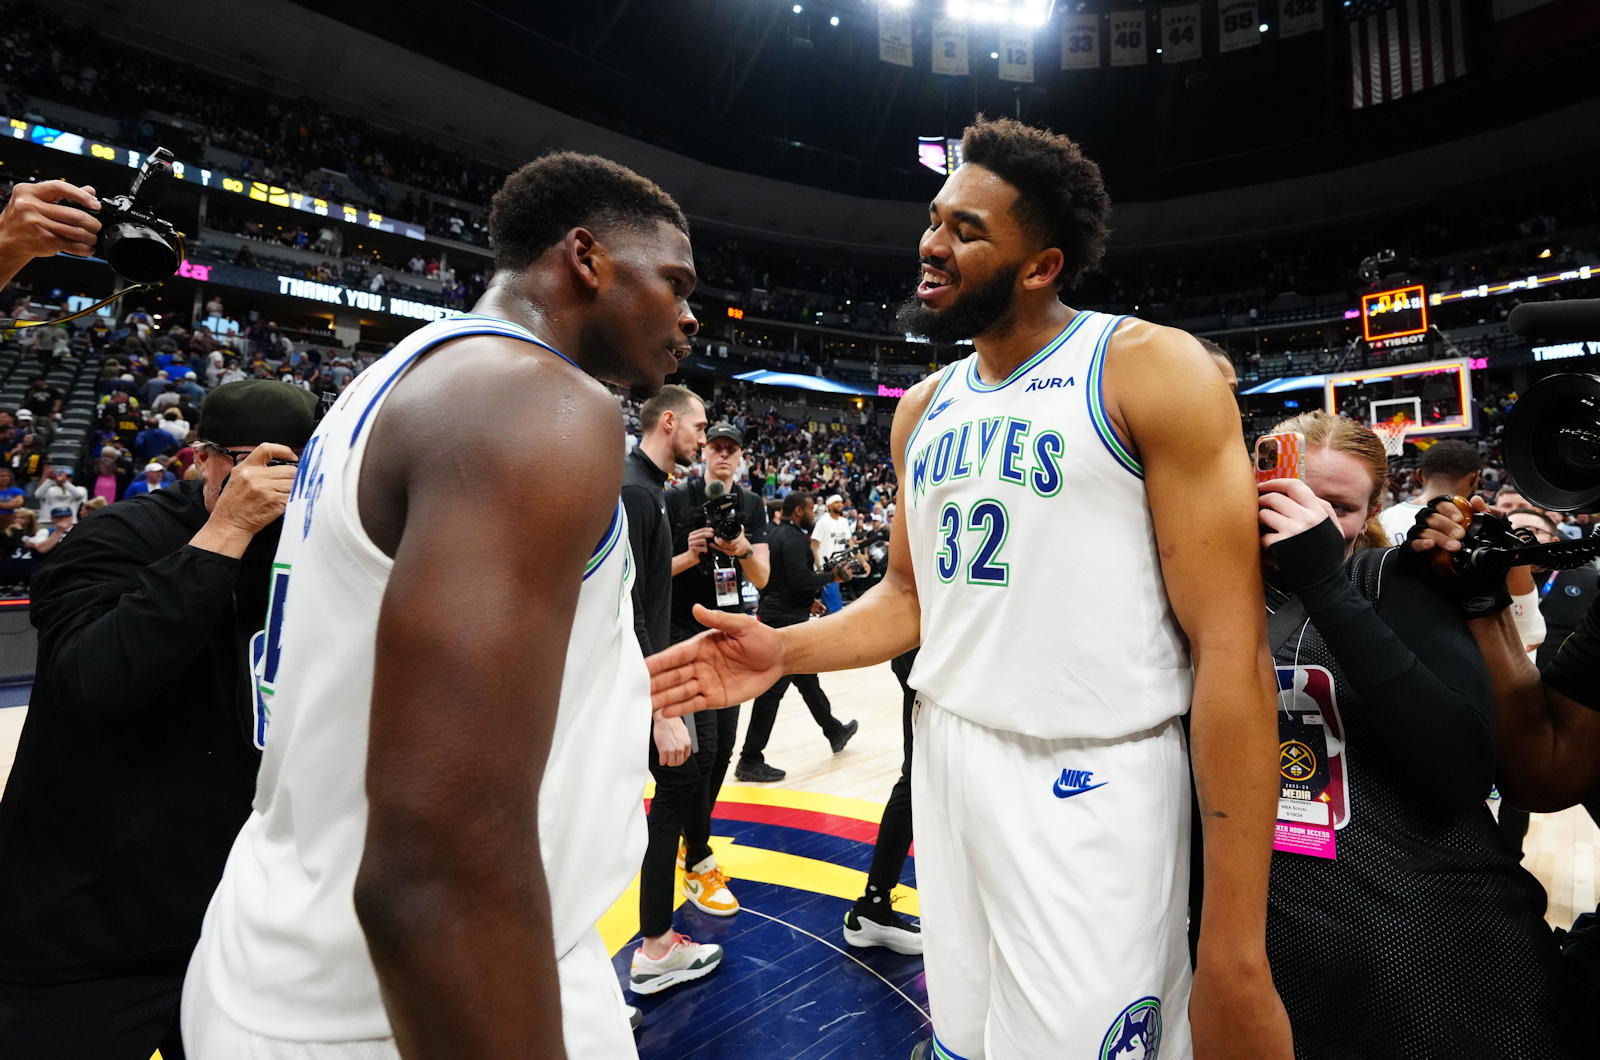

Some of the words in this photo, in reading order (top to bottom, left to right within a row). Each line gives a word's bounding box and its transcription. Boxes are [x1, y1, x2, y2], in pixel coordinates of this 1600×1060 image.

[1223, 11, 1255, 33] 55
[1068, 34, 1094, 53] 33
[1115, 30, 1141, 49] 40
[1168, 25, 1196, 45] 44
[943, 41, 957, 58] 2
[1006, 48, 1028, 66] 12
[130, 210, 152, 221] SONY
[277, 275, 343, 305] THANK
[345, 288, 386, 312] YOU,
[1383, 333, 1426, 348] TISSOT
[1531, 341, 1586, 362] THANK
[878, 384, 907, 398] ibott
[911, 416, 1065, 509] WOLVES
[936, 498, 1010, 588] 32
[1059, 768, 1094, 789] NIKE
[1281, 788, 1312, 801] MEDIA
[1289, 826, 1306, 835] ROOM
[1307, 829, 1330, 839] ACCESS
